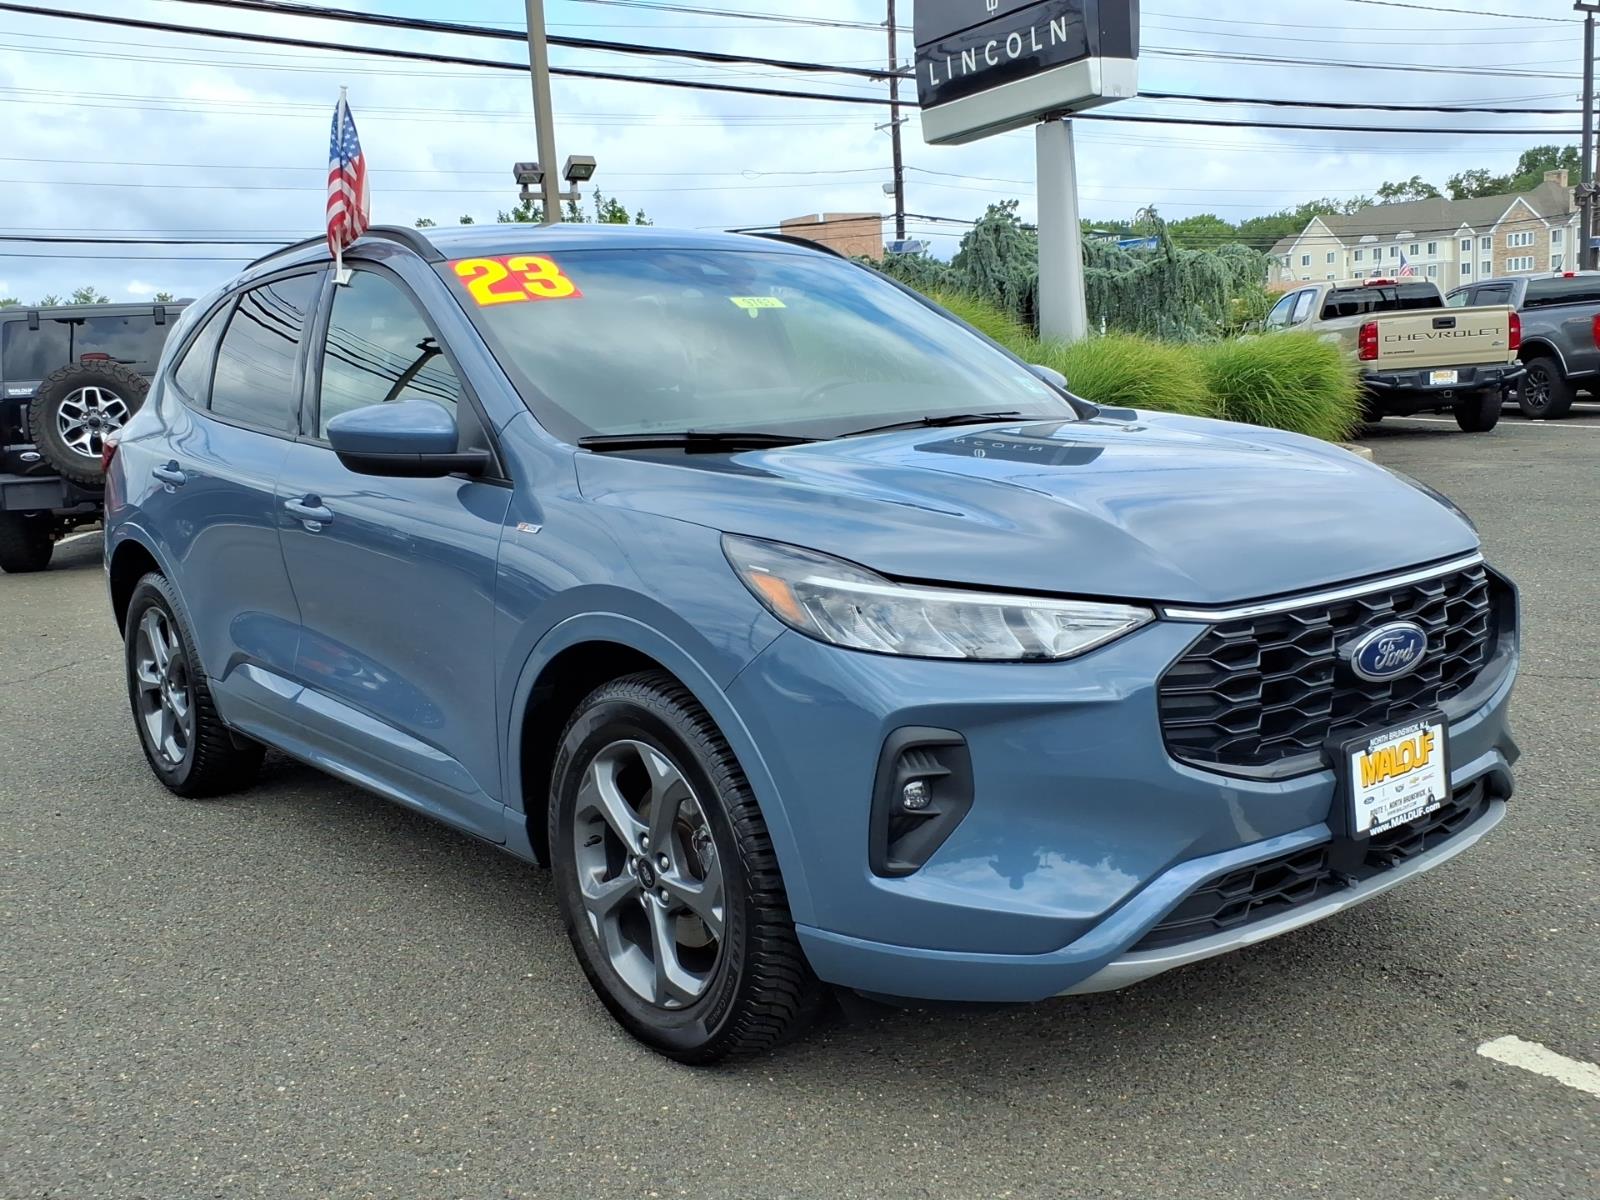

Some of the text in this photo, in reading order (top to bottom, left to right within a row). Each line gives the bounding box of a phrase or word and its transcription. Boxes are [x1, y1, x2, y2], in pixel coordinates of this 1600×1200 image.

[929, 16, 1067, 86] LINCOLN
[454, 256, 576, 306] 23
[1384, 327, 1505, 343] CHEVROLET
[1374, 635, 1415, 670] Ford
[1360, 730, 1435, 788] MALOUF
[1369, 801, 1441, 836] www.MALOUF.com
